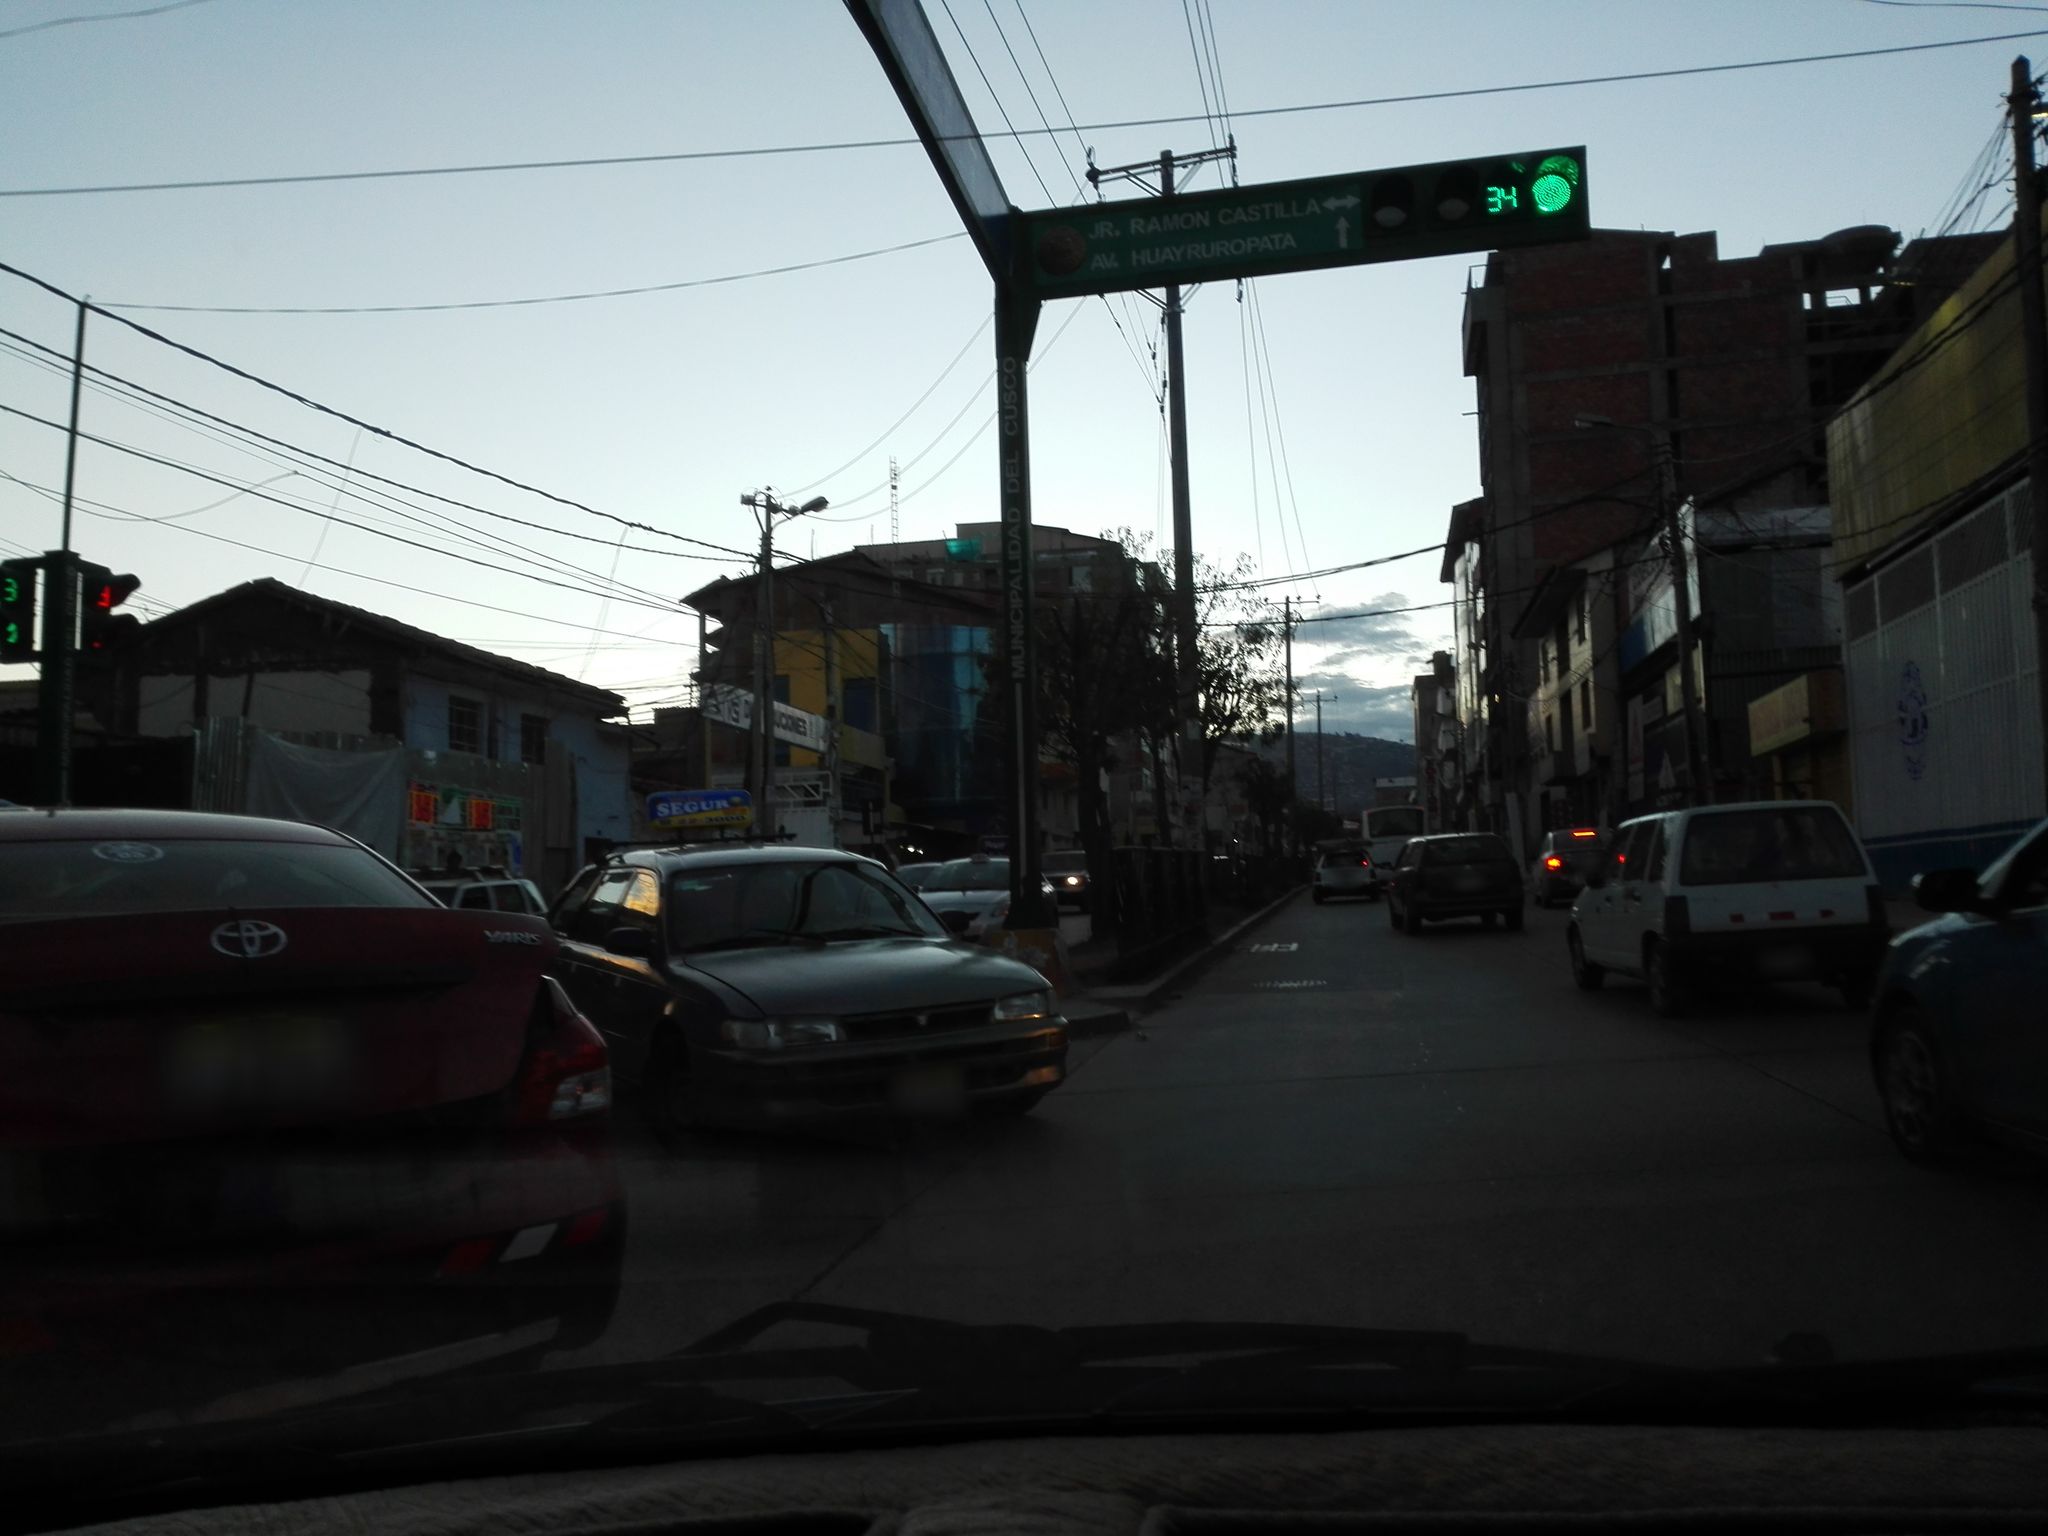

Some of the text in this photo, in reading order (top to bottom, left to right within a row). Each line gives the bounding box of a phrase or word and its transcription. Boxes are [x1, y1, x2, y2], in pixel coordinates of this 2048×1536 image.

[1088, 197, 1321, 242] JR. RAMON CASTILLA
[1487, 185, 1517, 215] 34
[1090, 232, 1297, 272] AV. HUAYRUROPATA
[1003, 356, 1026, 679] MUNICIPALIDAD DEL CUSCO
